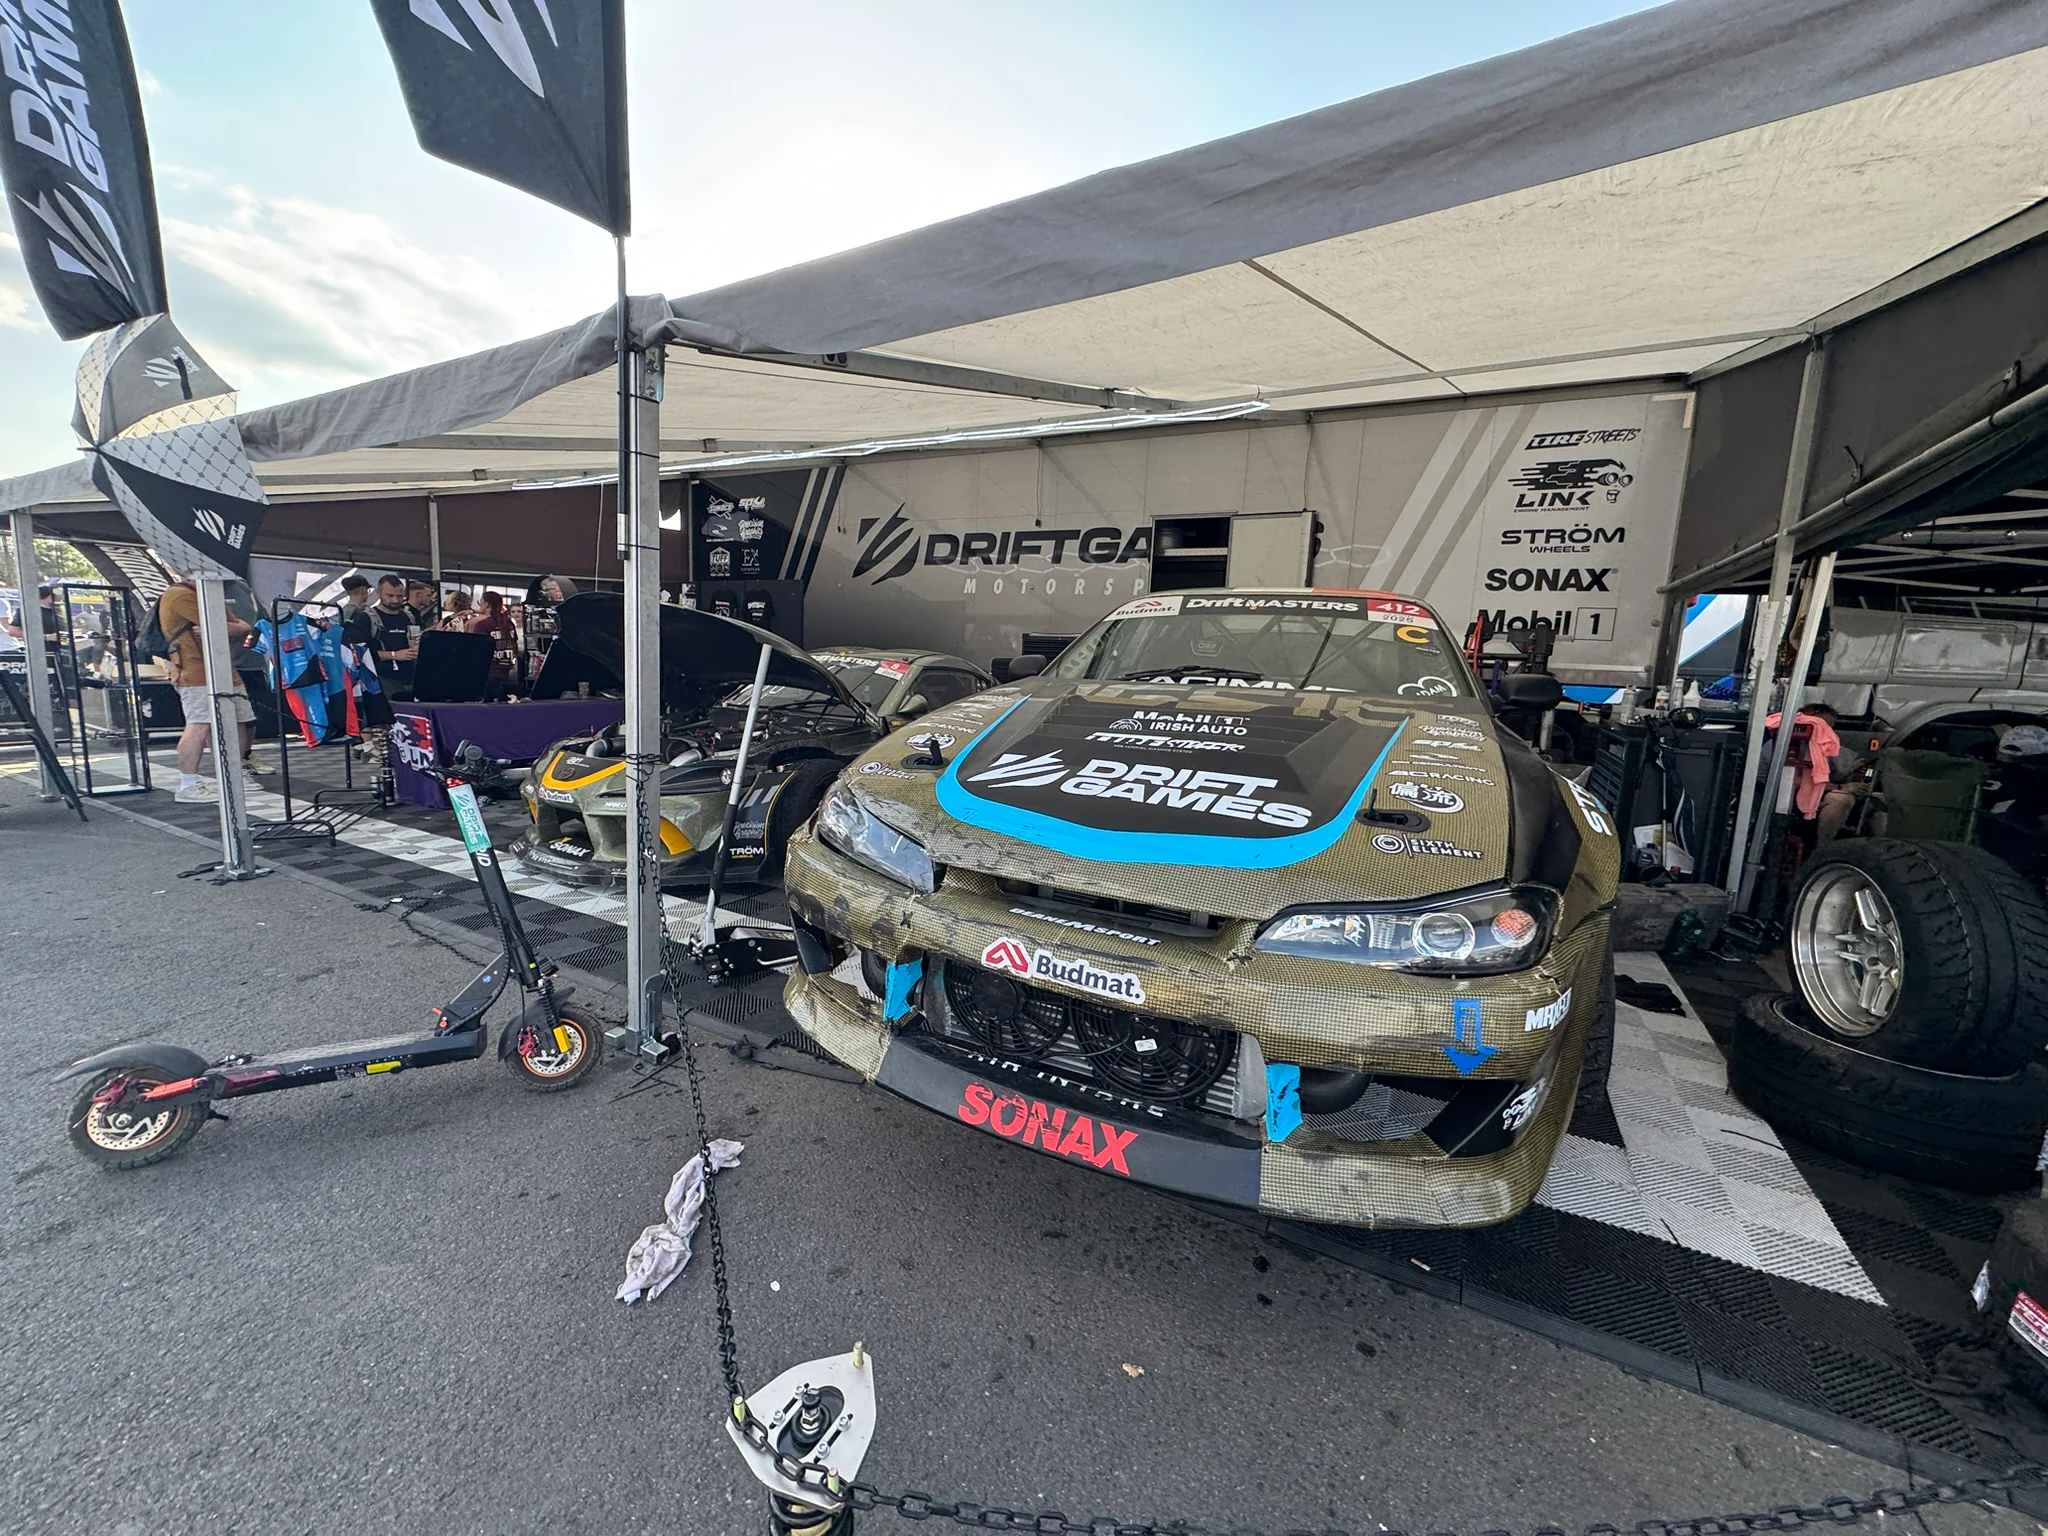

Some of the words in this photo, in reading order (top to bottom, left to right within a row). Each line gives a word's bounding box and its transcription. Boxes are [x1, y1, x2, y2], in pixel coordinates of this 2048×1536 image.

[22, 0, 109, 192] GAM
[1515, 490, 1595, 508] LINK
[226, 525, 239, 547] DRIFT
[234, 523, 247, 549] GAMES
[1500, 523, 1626, 545] STRÖM
[924, 526, 1153, 566] DRIFTGA
[1529, 545, 1591, 554] WHEELS
[963, 578, 1145, 596] MOTORSP
[1484, 568, 1612, 592] SONAX
[1375, 602, 1421, 615] 412
[1382, 614, 1414, 624] 2025
[1396, 625, 1430, 644] C
[1590, 613, 1601, 635] 1
[1149, 721, 1195, 732] IRISH
[1197, 724, 1248, 736] AUTO
[1076, 759, 1278, 797] DRIFT
[1060, 777, 1312, 828] GAMES
[459, 808, 478, 845] GAMES
[467, 807, 483, 838] DRIFT
[729, 845, 764, 855] TRÖM
[1411, 838, 1455, 849] SIXTH
[1411, 844, 1483, 859] ELEMENT
[1036, 953, 1141, 999] Budmat.
[958, 1081, 1139, 1176] SONAX
